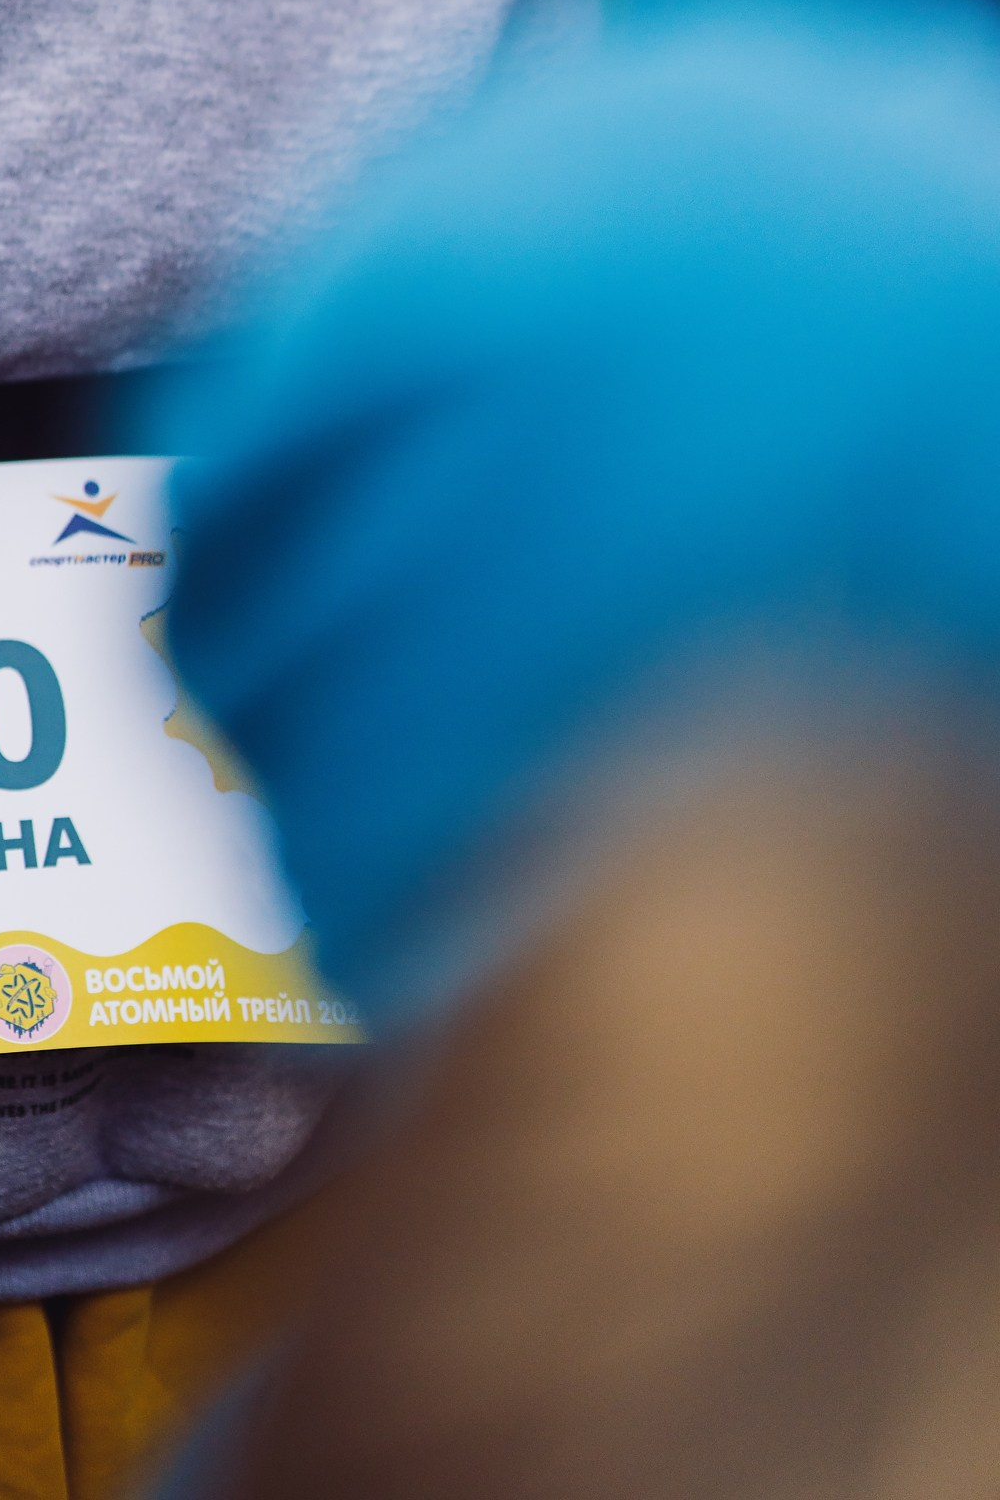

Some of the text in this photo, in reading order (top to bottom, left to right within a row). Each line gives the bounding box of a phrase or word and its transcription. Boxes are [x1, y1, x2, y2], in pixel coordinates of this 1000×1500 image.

[130, 551, 166, 567] PRO
[85, 958, 226, 994] ВОСЬМОЙ
[89, 991, 362, 1026] АТОМНЫЙ ТРЕЙЛ 202
[31, 1101, 57, 1116] THE
